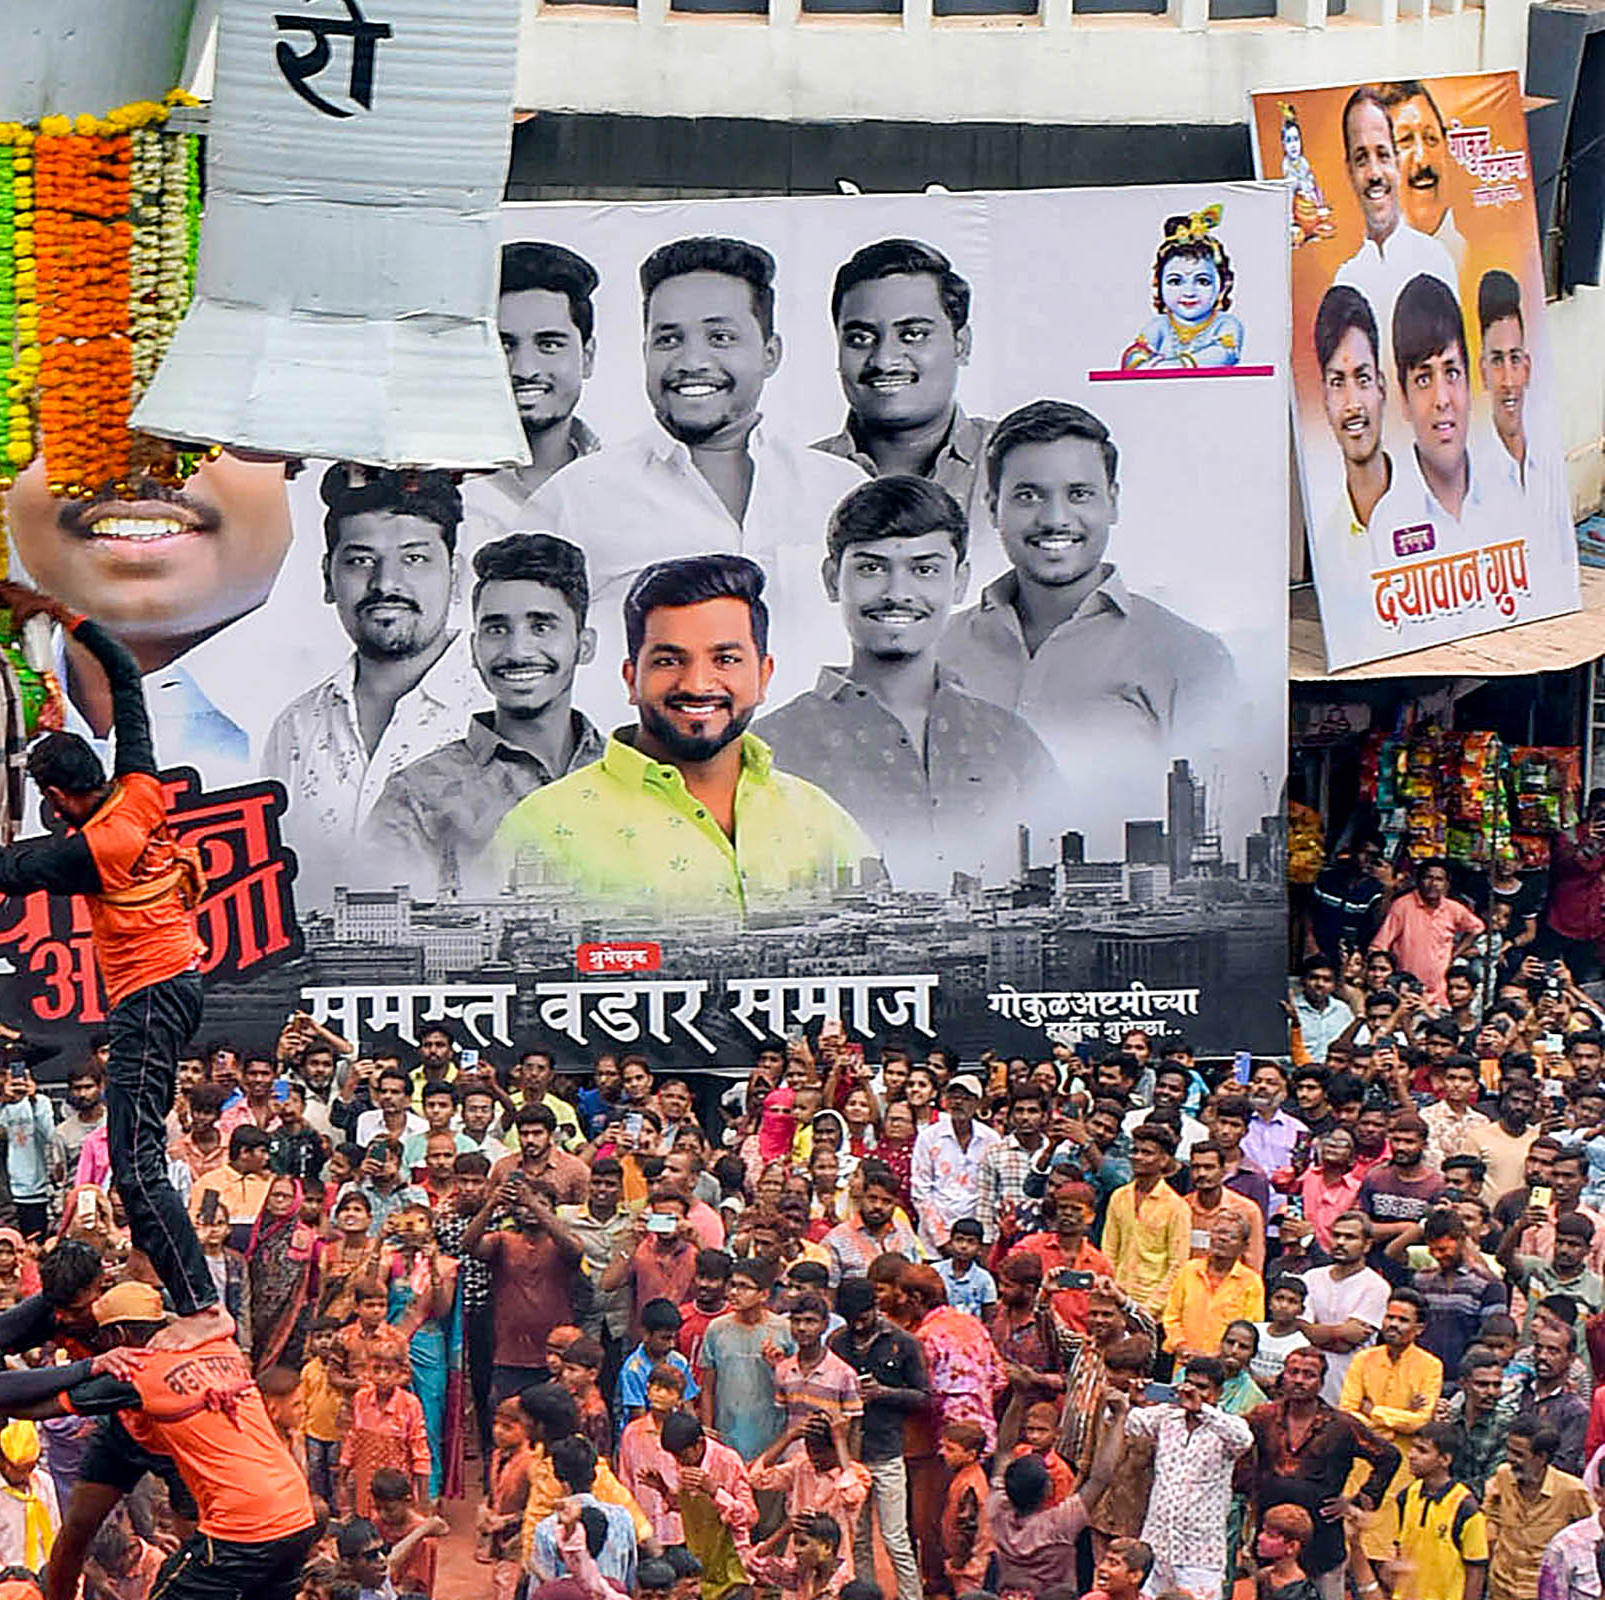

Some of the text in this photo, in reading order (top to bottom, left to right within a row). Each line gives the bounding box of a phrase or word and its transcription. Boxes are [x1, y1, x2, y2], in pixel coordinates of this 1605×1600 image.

[1370, 549, 1482, 626] दयावान
[300, 974, 939, 1058] समस्त वडार समाज
